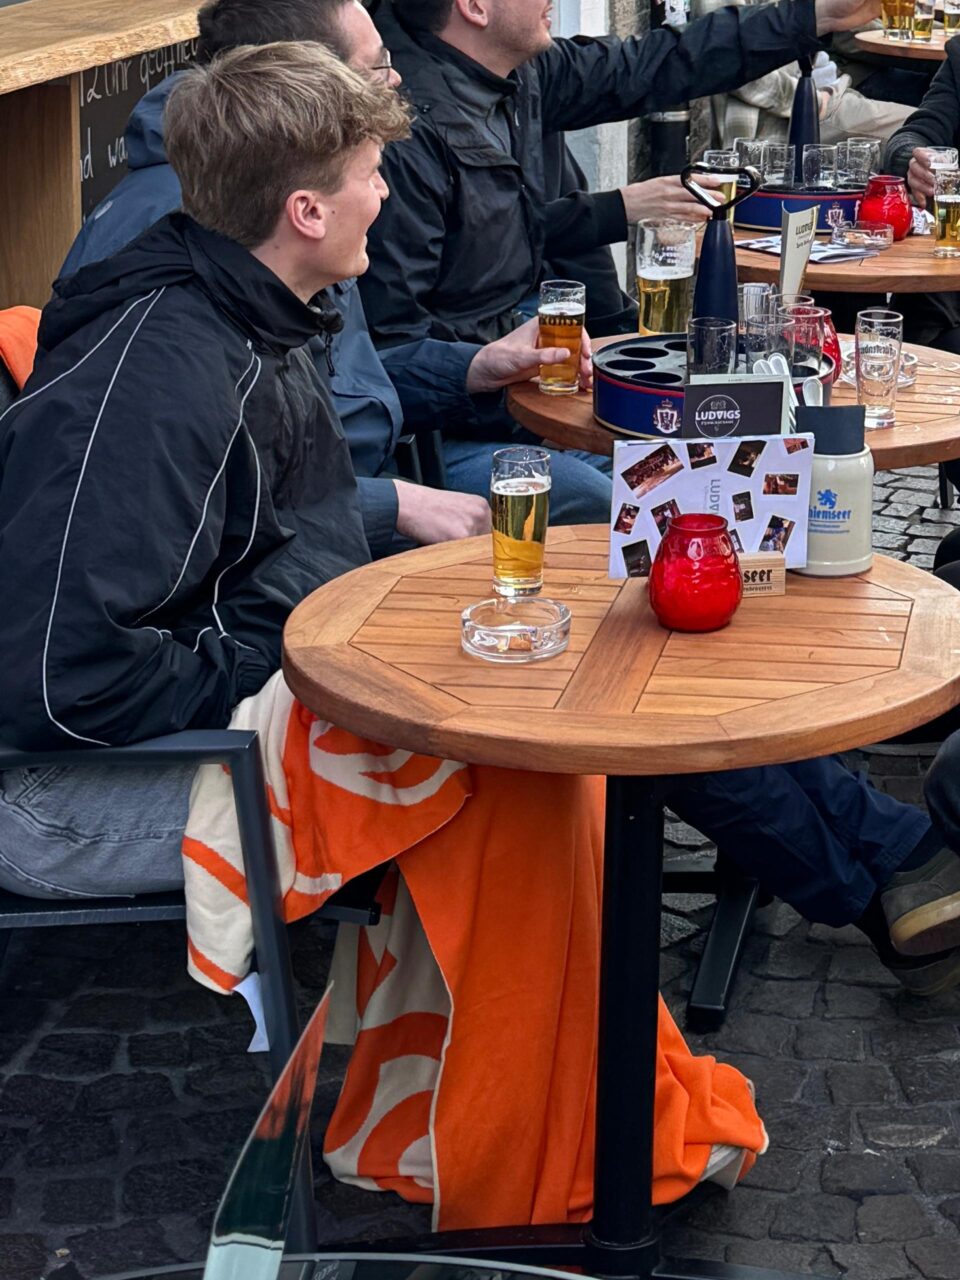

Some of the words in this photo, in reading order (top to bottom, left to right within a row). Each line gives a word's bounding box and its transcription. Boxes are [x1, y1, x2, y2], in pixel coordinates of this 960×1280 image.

[695, 409, 740, 421] LUDVIGS
[710, 479, 721, 512] LUDV
[808, 505, 851, 519] hiemseer
[743, 569, 772, 583] seer
